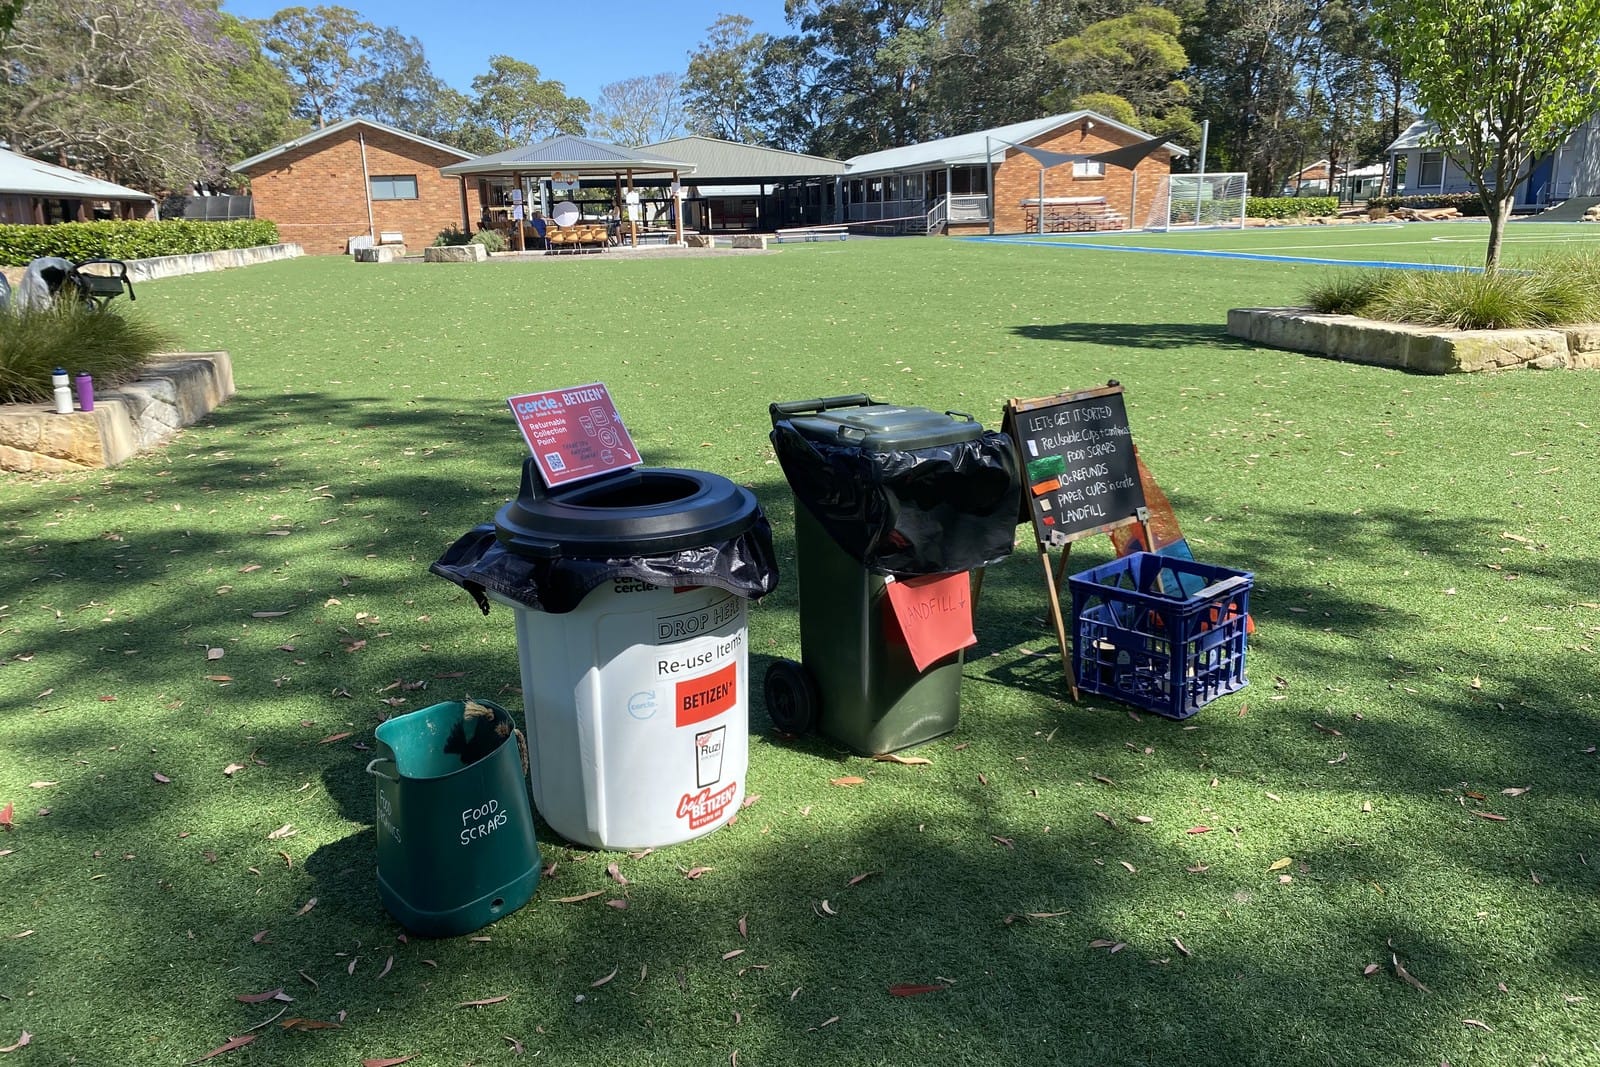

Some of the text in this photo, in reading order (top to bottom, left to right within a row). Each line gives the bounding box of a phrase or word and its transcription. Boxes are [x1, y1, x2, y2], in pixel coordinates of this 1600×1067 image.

[529, 418, 566, 430] Returnable
[1054, 411, 1071, 426] GET
[1073, 409, 1080, 421] IT
[1082, 405, 1112, 421] SORTED
[533, 427, 567, 438] Collection
[537, 437, 557, 446] Point
[1067, 441, 1116, 463] FOOD SCRAPS
[1058, 489, 1084, 508] PAPER
[1085, 481, 1108, 496] CUPS
[1061, 503, 1106, 524] LANDFILL
[658, 613, 709, 640] DROP
[658, 633, 742, 675] Re-use Items
[701, 740, 721, 756] Ruzi
[462, 799, 498, 827] FOOD
[460, 810, 508, 845] SCRAPS
